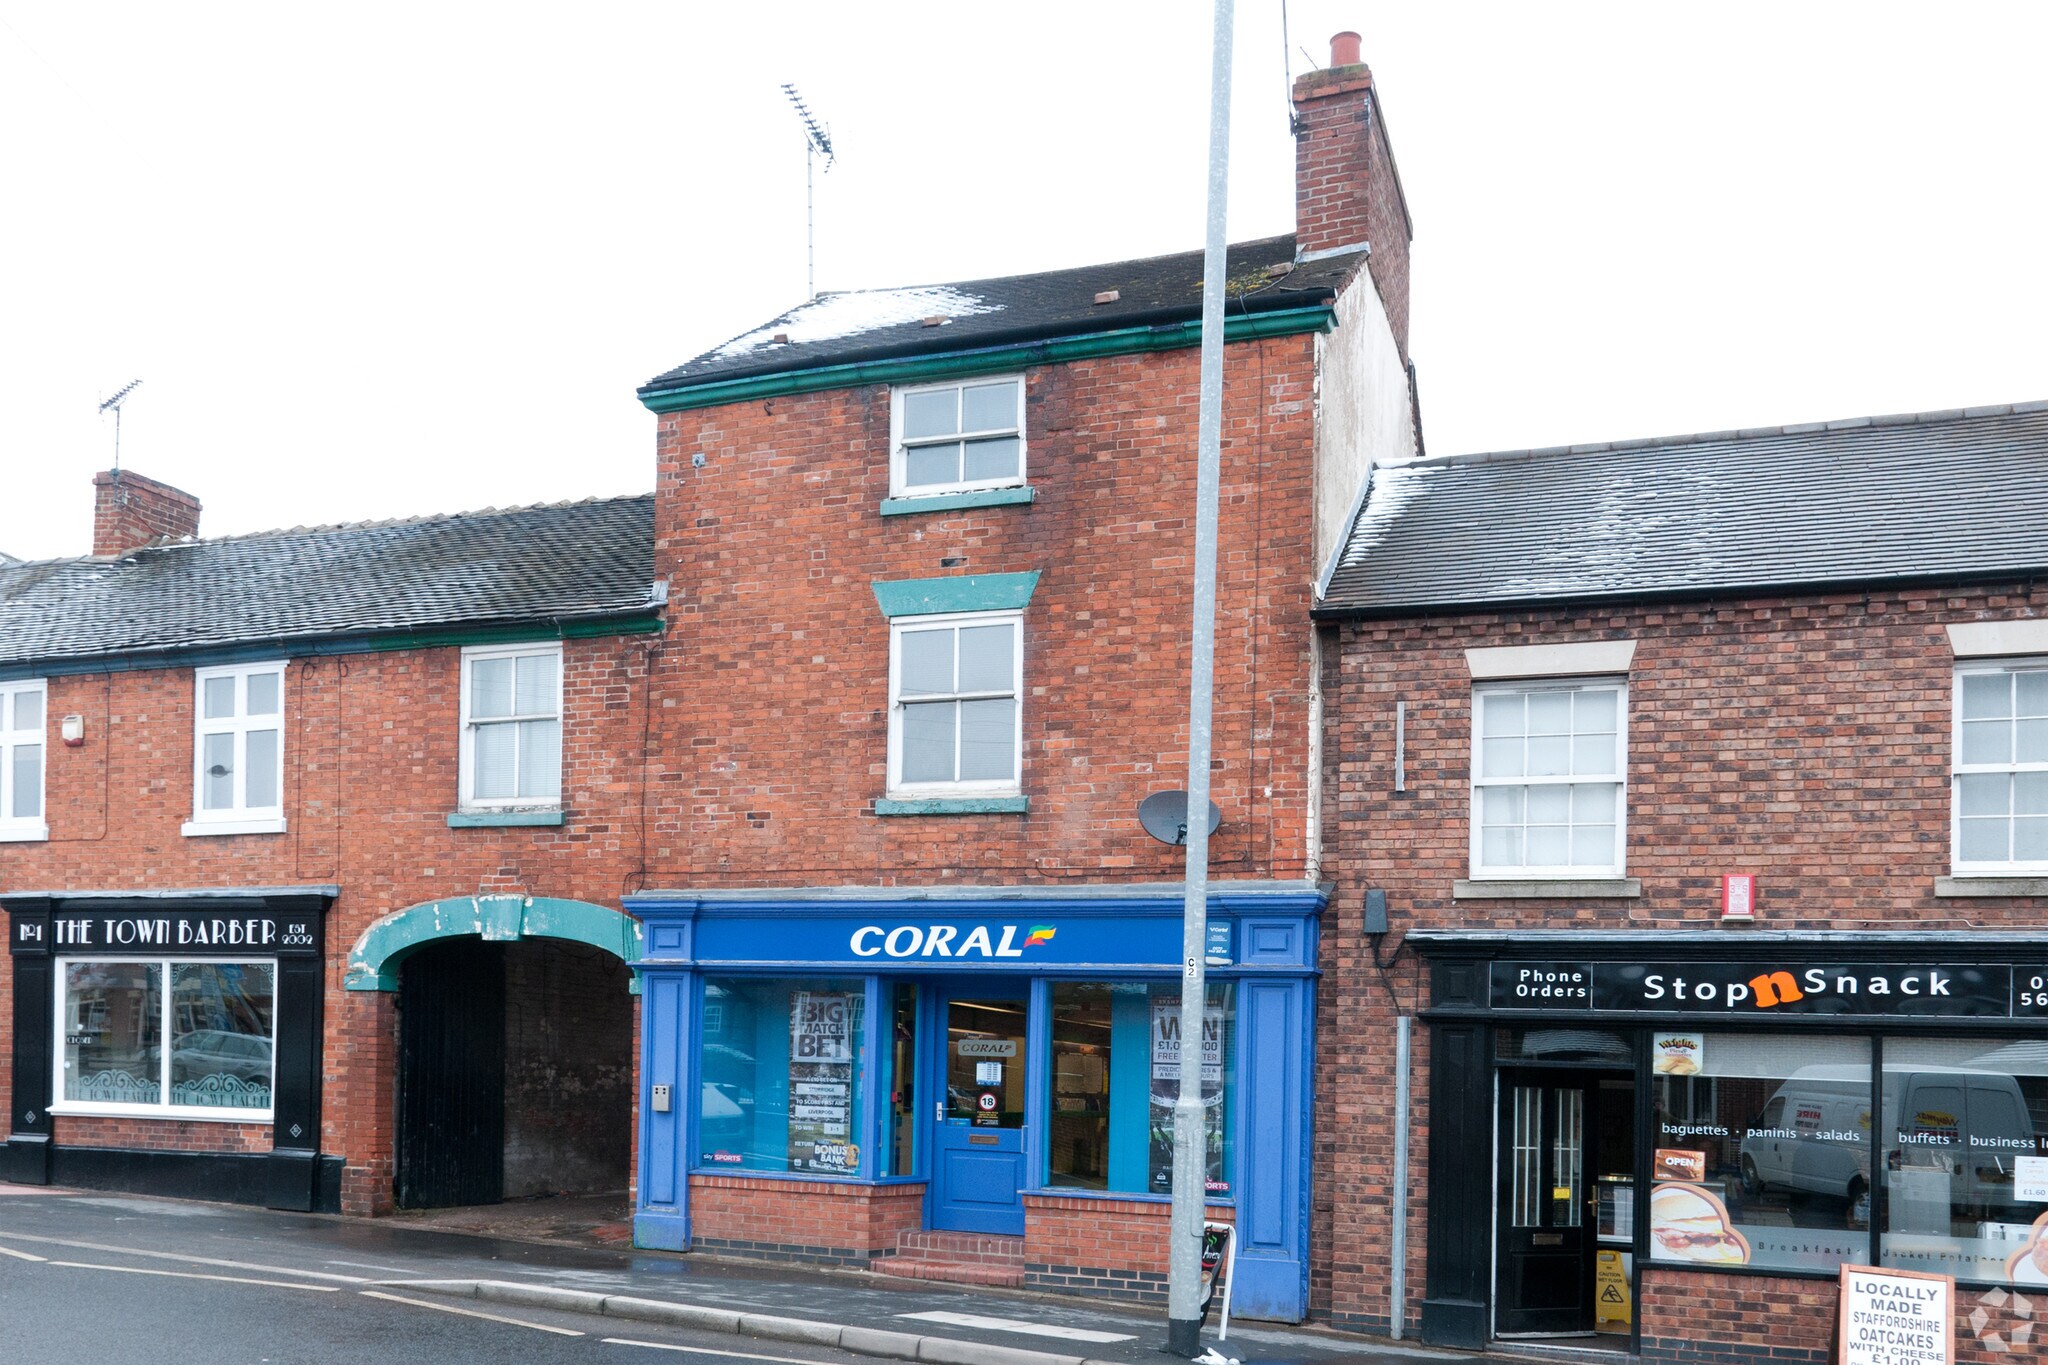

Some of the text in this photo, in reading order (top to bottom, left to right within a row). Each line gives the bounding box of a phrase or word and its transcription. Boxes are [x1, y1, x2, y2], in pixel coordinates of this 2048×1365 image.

[54, 919, 276, 944] THE TOWN BARBER
[289, 924, 306, 934] EST
[281, 934, 313, 944] 2002
[850, 925, 1023, 957] CORAL
[1188, 958, 1195, 967] C
[1188, 968, 1195, 976] 2
[1520, 969, 1582, 982] Phone
[1804, 968, 1950, 996] Snack
[1516, 984, 1586, 998] Orders
[801, 1001, 844, 1023] BIG
[800, 1023, 844, 1035] MATCH
[1158, 1016, 1218, 1041] WN
[798, 1034, 846, 1058] BET
[962, 1043, 1005, 1053] CORAL
[1157, 1052, 1179, 1060] FREE
[1158, 1066, 1181, 1074] PREDIC
[982, 1098, 994, 1106] 18
[1662, 1123, 1729, 1137] baguettes
[1747, 1127, 1797, 1139] paninis
[1815, 1129, 1860, 1141] salads
[1898, 1132, 1950, 1145] buffets
[1970, 1134, 2036, 1148] business
[814, 1145, 849, 1156] BONUS
[820, 1154, 846, 1165] BANK
[1665, 1157, 1695, 1167] OPEN
[1855, 1281, 1938, 1301] LOCALLY
[1871, 1298, 1922, 1315] MADE
[1853, 1311, 1940, 1333] STAFFORDSHIRE
[1859, 1327, 1934, 1349] OATCAKES
[1849, 1341, 1944, 1361] WITH CHEESE
[1872, 1353, 1921, 1365] £1.00
